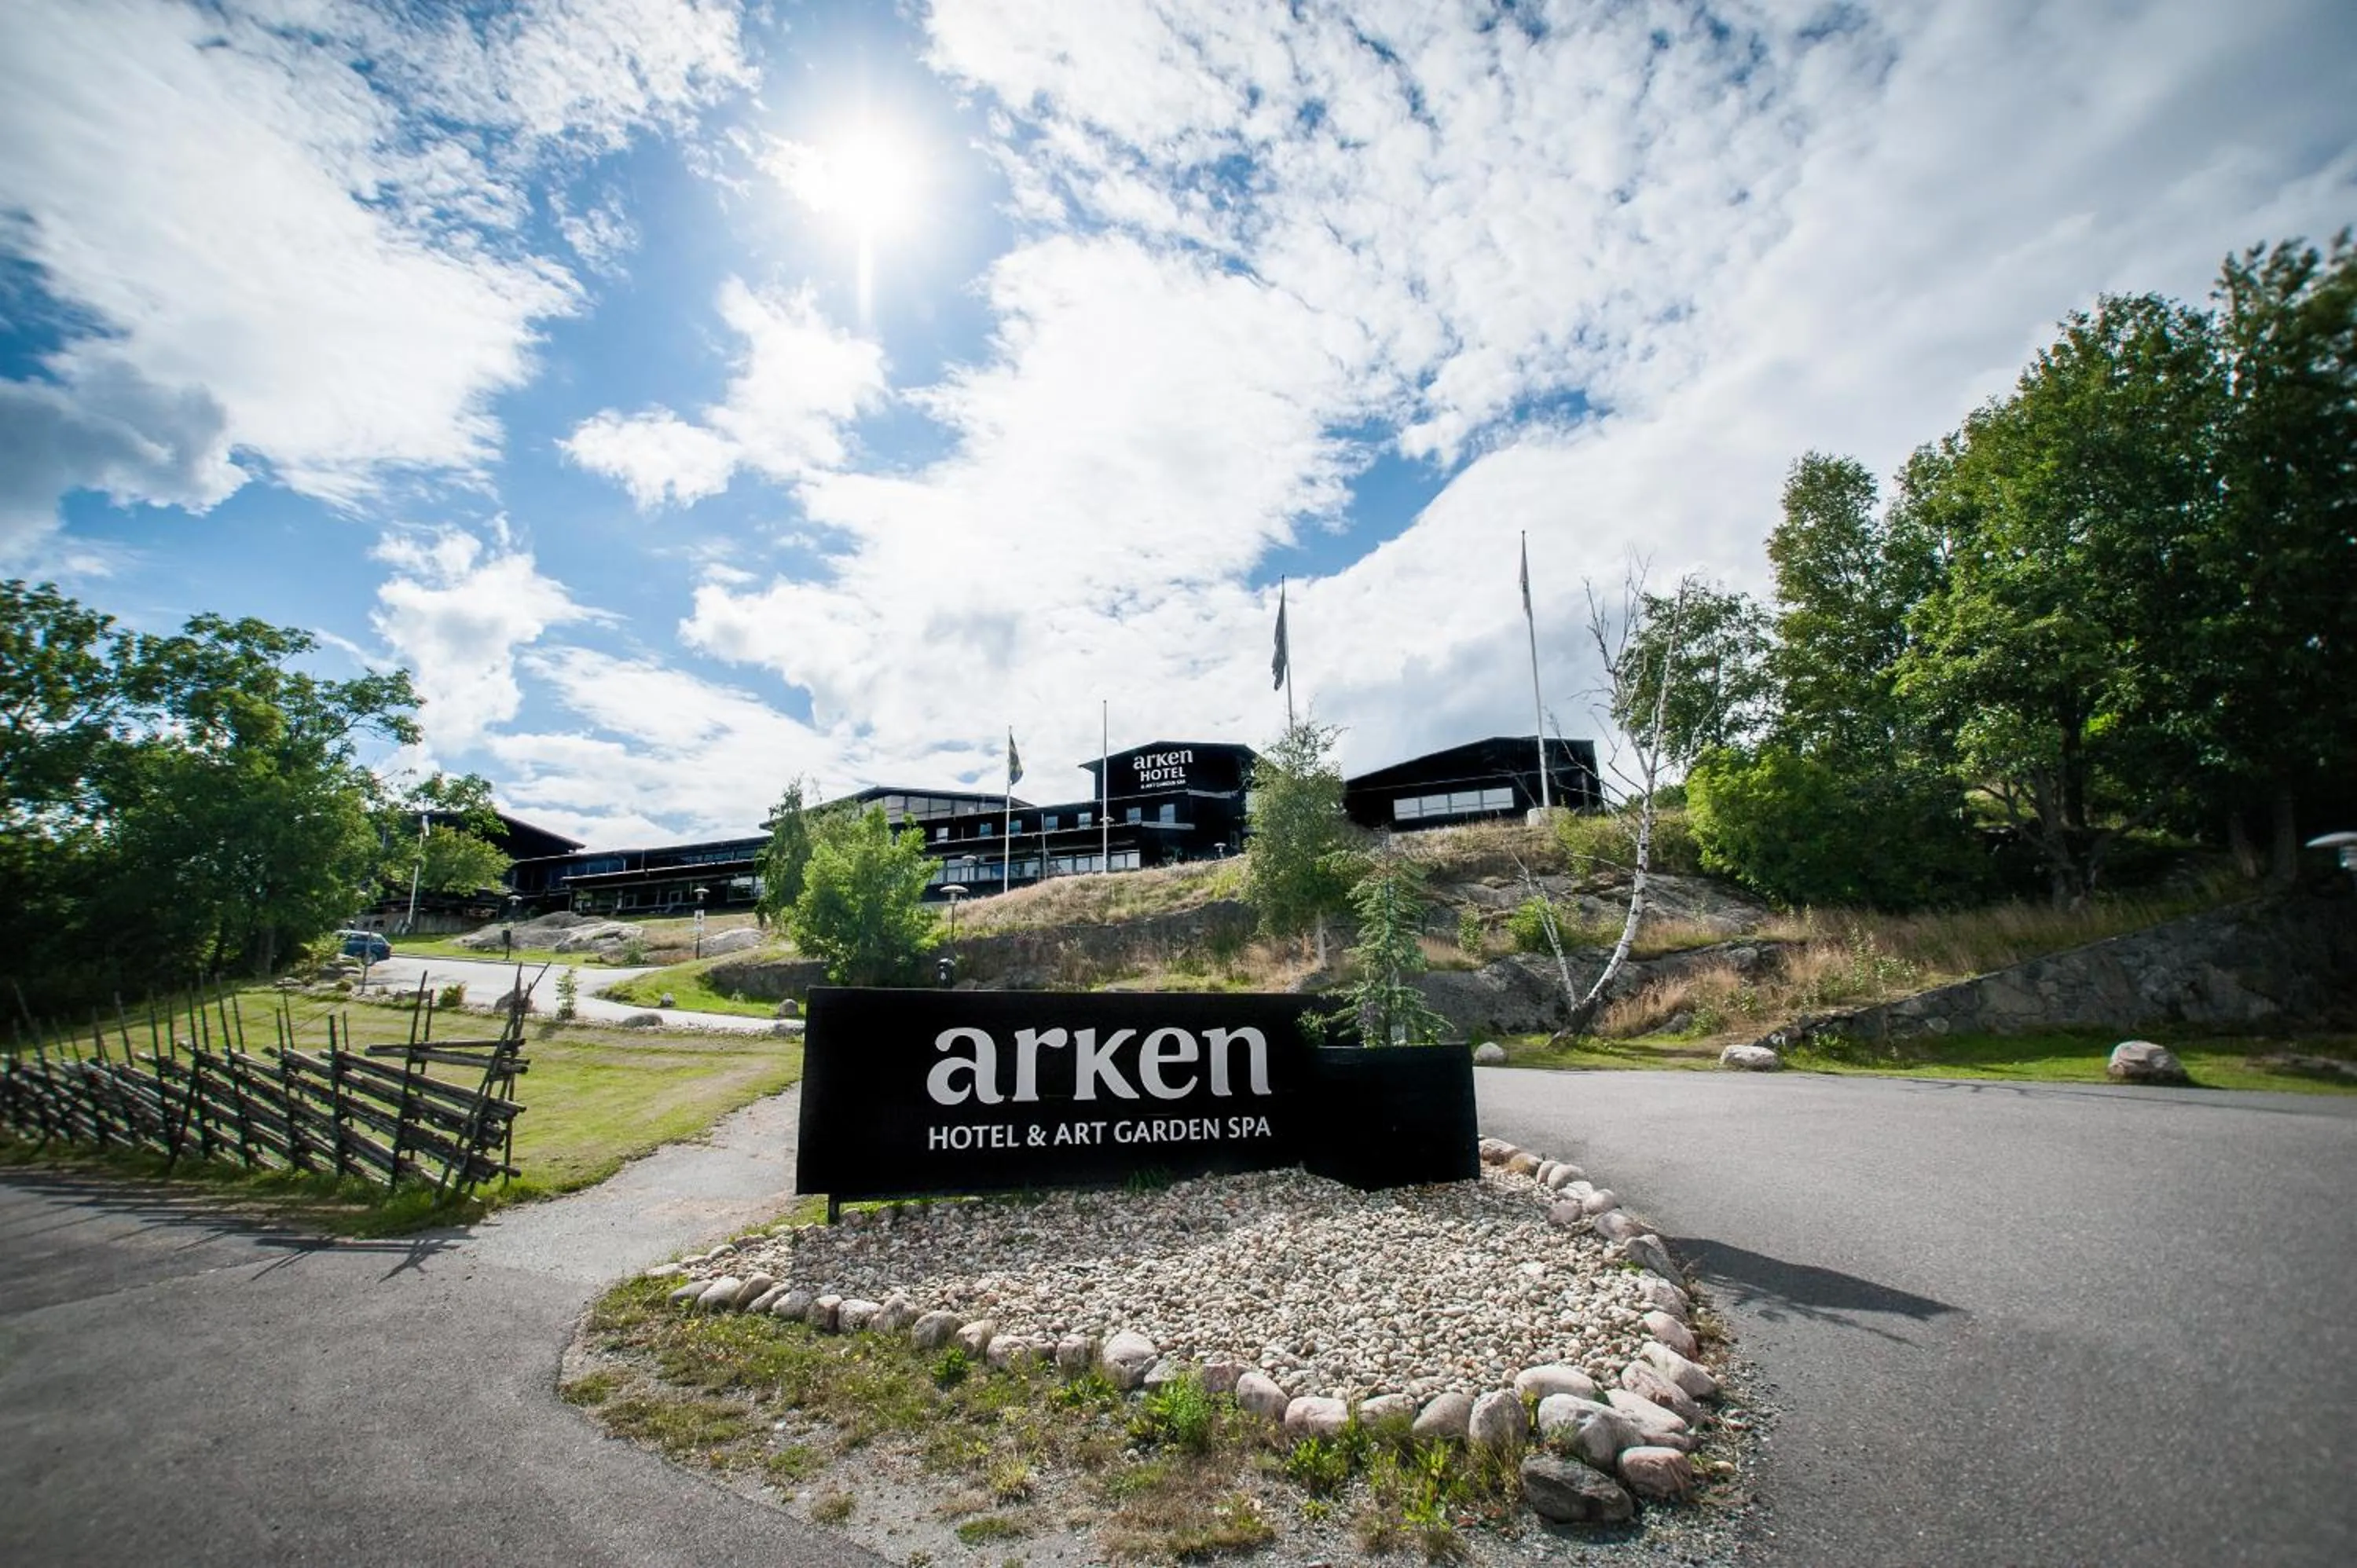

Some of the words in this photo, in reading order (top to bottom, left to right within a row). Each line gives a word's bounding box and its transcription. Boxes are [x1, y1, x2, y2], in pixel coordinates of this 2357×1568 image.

[1140, 767, 1186, 782] HOTEL
[926, 1027, 1272, 1105] arken
[929, 1124, 1020, 1150] HOTEL
[1027, 1124, 1047, 1147] &
[1054, 1121, 1107, 1145] ART
[1113, 1118, 1220, 1144] GARDEN
[1228, 1116, 1272, 1138] SPA
